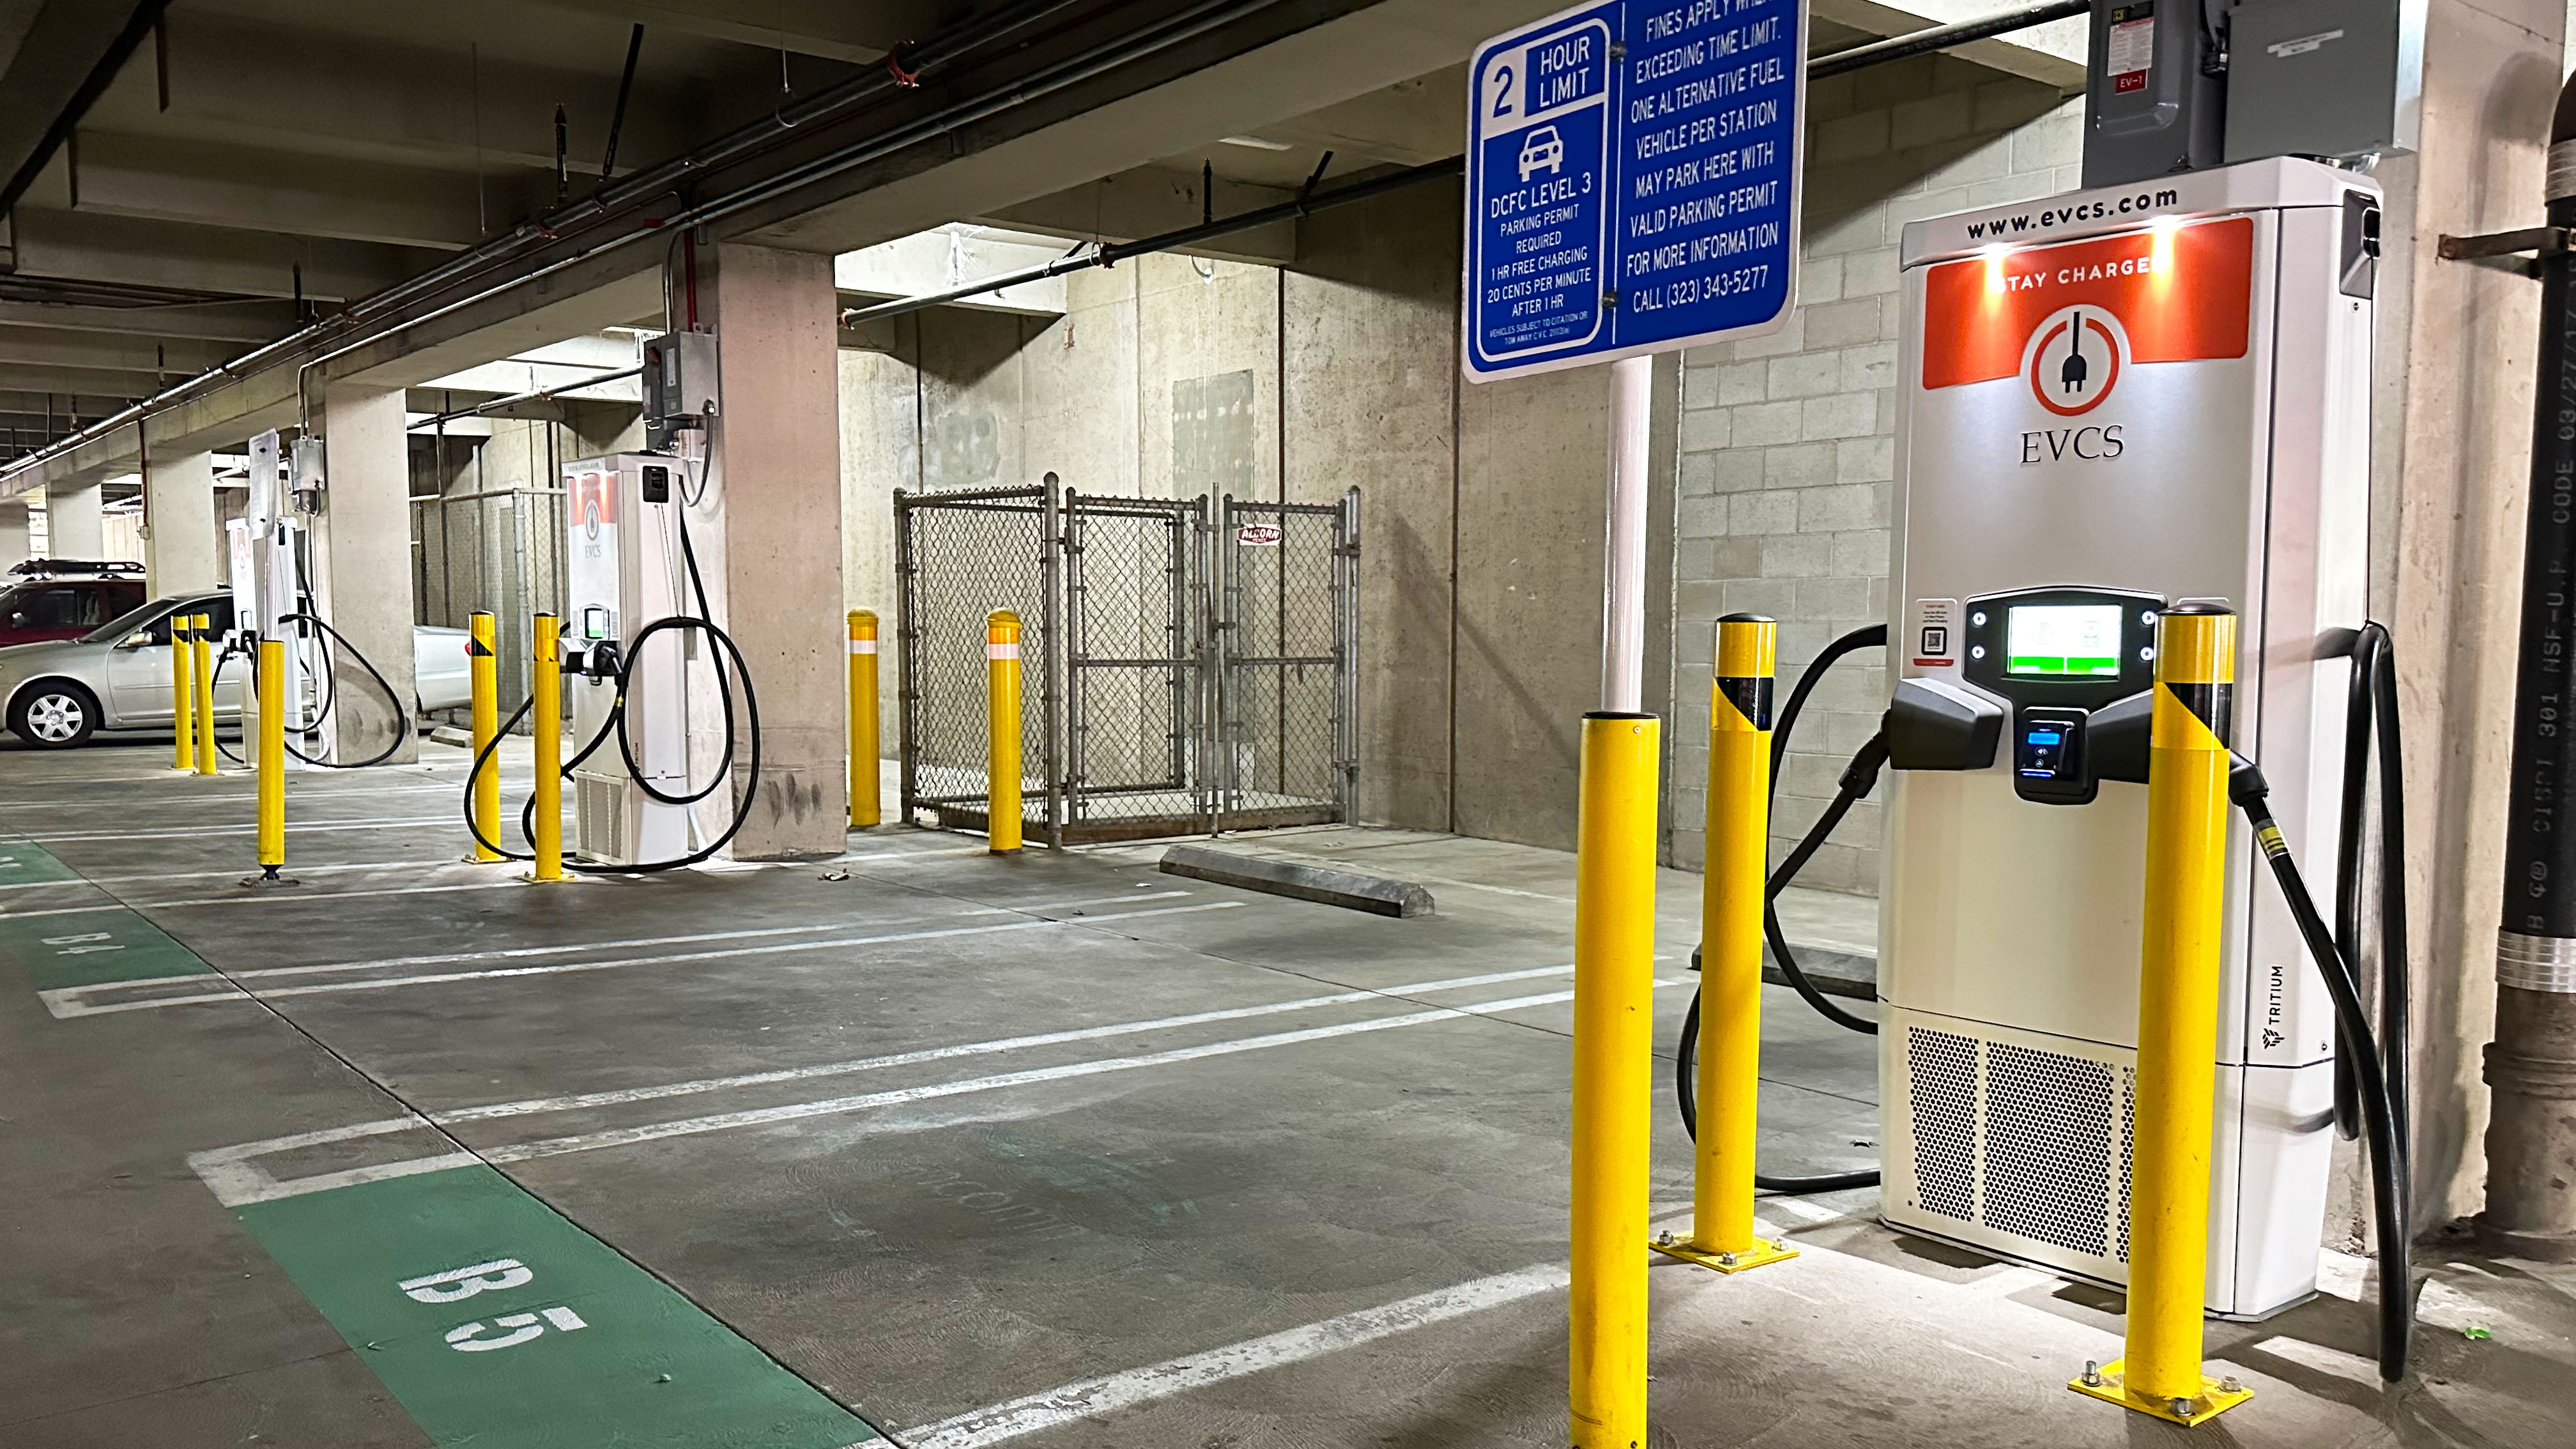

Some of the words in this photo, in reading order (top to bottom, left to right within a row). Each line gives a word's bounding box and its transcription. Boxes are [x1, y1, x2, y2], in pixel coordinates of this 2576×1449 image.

[1646, 9, 1682, 42] FINES
[1685, 0, 1729, 29] APPLY
[1540, 36, 1590, 75] HOUR
[1636, 41, 1704, 84] EXCEEDING
[1708, 29, 1738, 60] TIME
[1742, 16, 1781, 50] LIMIT.
[1493, 66, 1513, 118] 2
[1540, 67, 1590, 107] LIMIT
[1631, 96, 1655, 123] ONE
[1659, 67, 1746, 116] ALTERNATIVE
[1750, 57, 1784, 88] FUEL
[2120, 75, 2142, 88] EV-1
[1636, 125, 1687, 160] VEHICLE
[1690, 116, 1715, 145] PER
[1719, 98, 1777, 137] STATION
[1636, 170, 1662, 199] MAY
[1666, 160, 1699, 190] PARK
[1704, 150, 1737, 181] HERE
[1741, 140, 1774, 171] WITH
[1491, 190, 1526, 218] DCFC
[1531, 177, 1576, 208] LEVEL
[1582, 172, 1591, 193] 3
[1630, 209, 1666, 238] VALID
[1669, 194, 1725, 229] PARKING
[1729, 180, 1777, 215] PERMIT
[1967, 190, 2177, 239] www.evcs.com
[1501, 214, 1541, 237] PARKING
[1544, 204, 1579, 226] PERMIT
[1516, 231, 1561, 254] REQUIRED
[1492, 268, 1495, 281] 1
[1497, 265, 1509, 280] HR
[1512, 259, 1535, 276] FREE
[1538, 246, 1588, 270] CHARGING
[1627, 251, 1650, 277] FOR
[1653, 242, 1686, 271] MORE
[1690, 221, 1779, 263] INFORMATION
[1487, 288, 1499, 303] 20
[1503, 281, 1531, 300] CENTS
[1534, 276, 1552, 293] PER
[1556, 267, 1591, 288] MINUTE
[1512, 298, 1542, 317] AFTER
[1545, 297, 1548, 310] 1
[1551, 294, 1563, 309] HR
[1634, 288, 1663, 313] CALL
[1667, 279, 1700, 309] (323)
[1703, 264, 1768, 299] 343-5277
[1490, 325, 1515, 337] VEHICLES
[1516, 320, 1540, 332] SUBJECT
[1543, 318, 1551, 327] TO
[1551, 312, 1578, 325] CITATION
[1579, 310, 1588, 320] OR
[2020, 424, 2124, 464] EVCS
[2538, 693, 2558, 737] 301
[2552, 457, 2575, 524] CODE
[2269, 966, 2283, 1025] TRITIUM
[397, 1259, 588, 1351] B5
